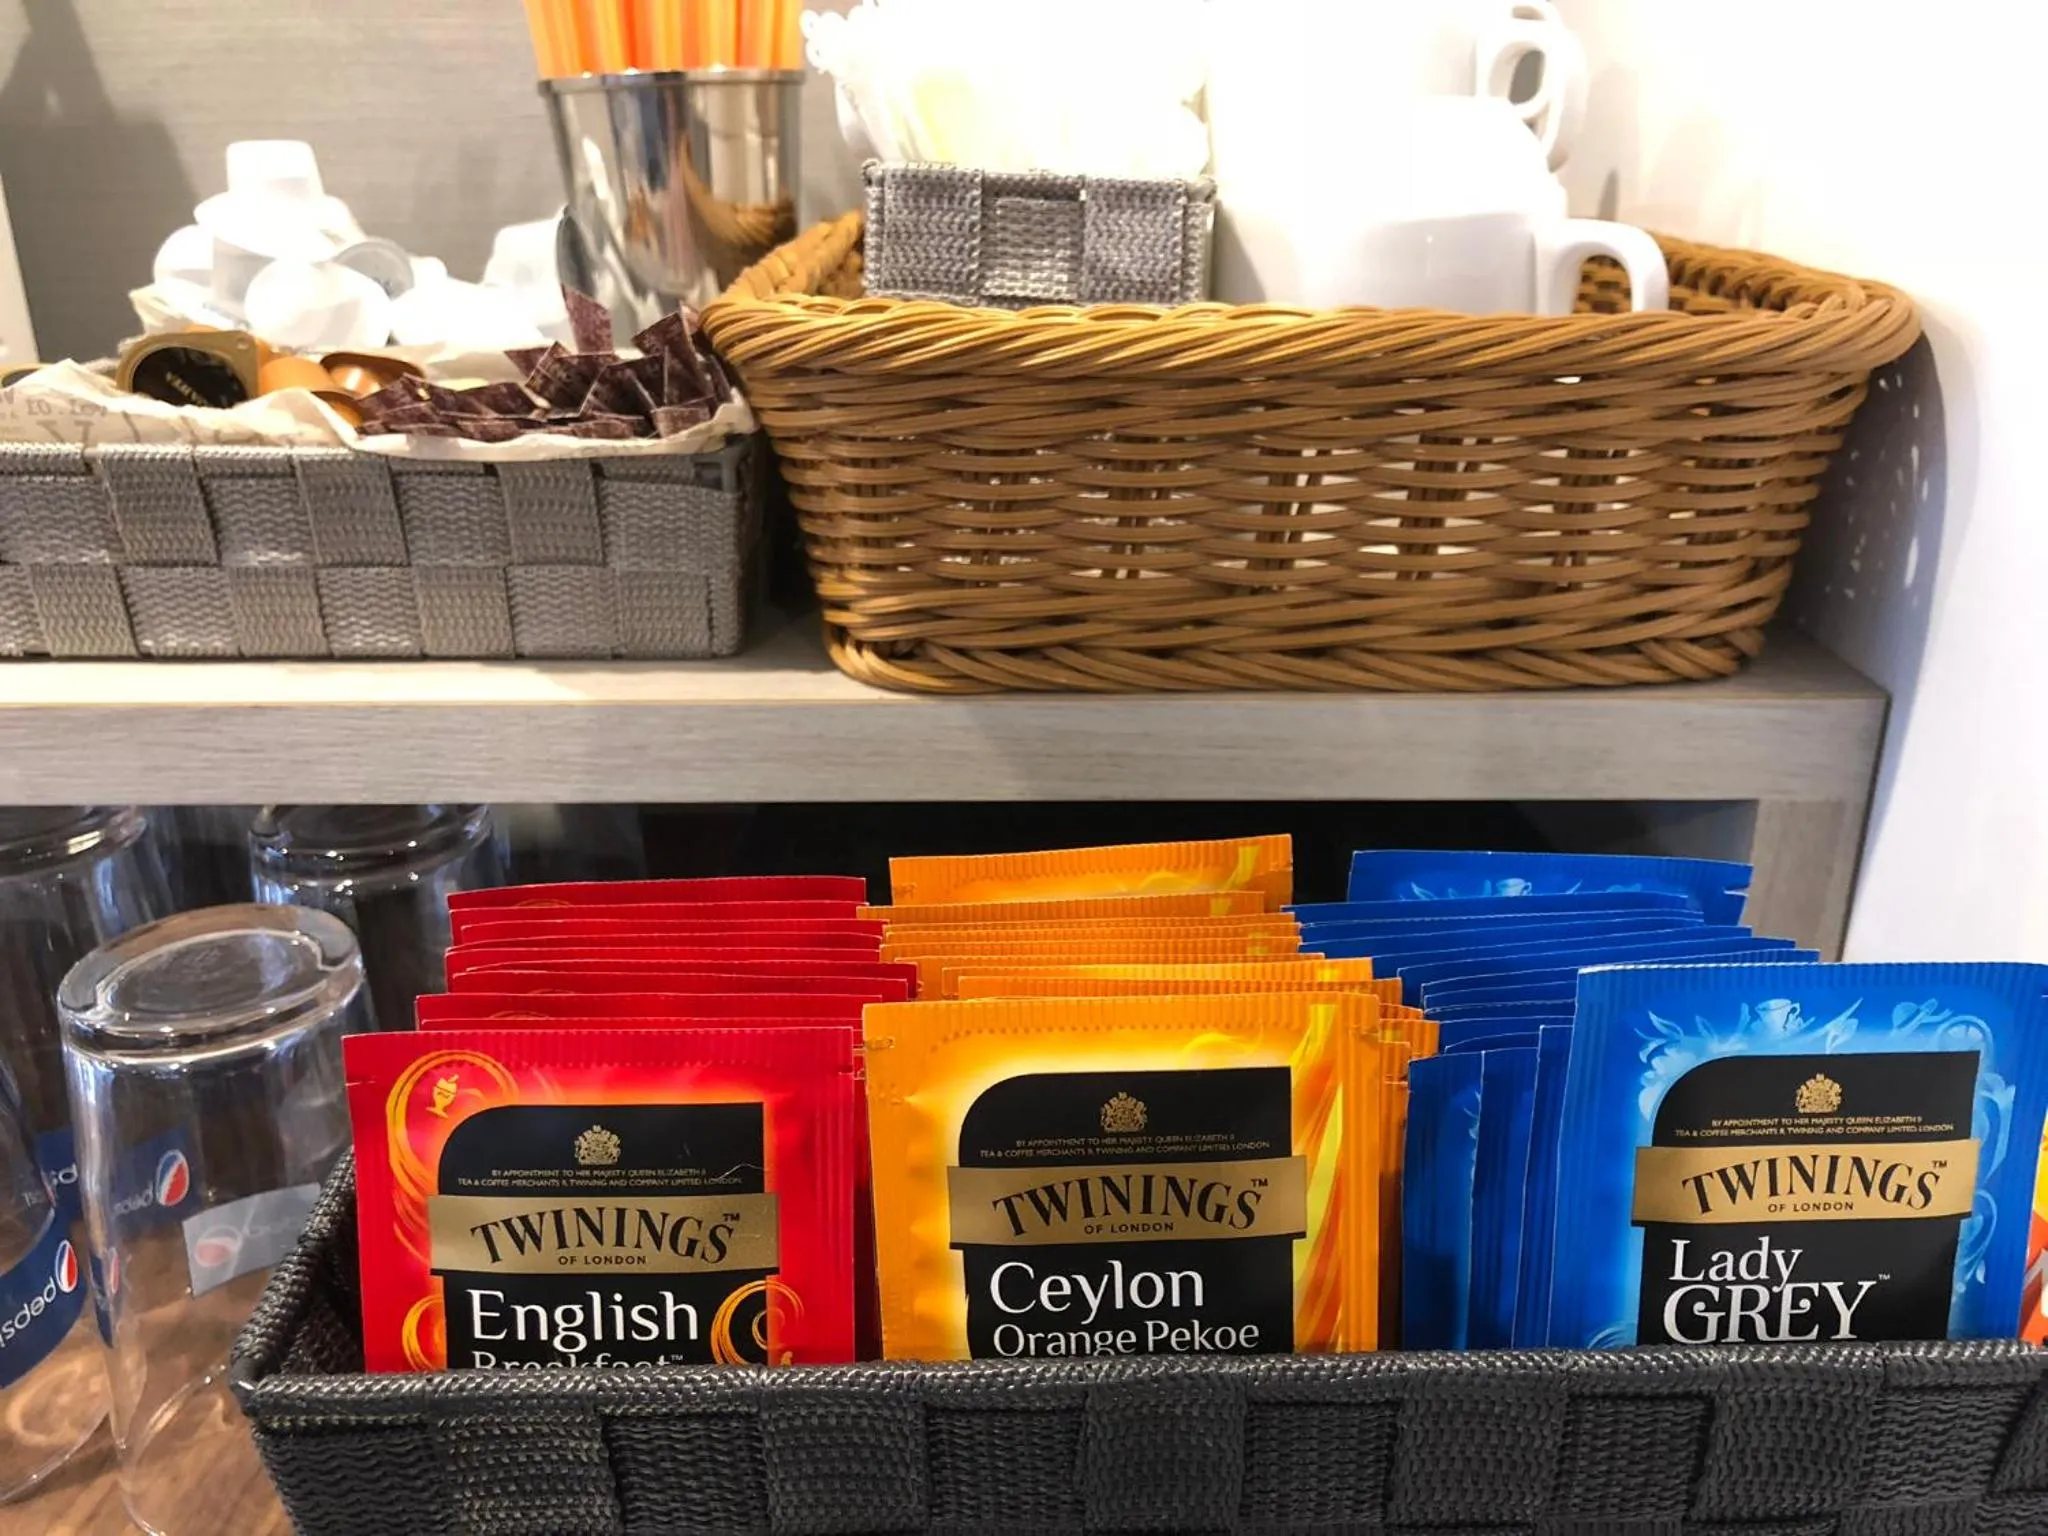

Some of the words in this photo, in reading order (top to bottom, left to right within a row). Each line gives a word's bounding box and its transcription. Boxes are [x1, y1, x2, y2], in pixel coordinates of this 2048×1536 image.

[1768, 1202, 1786, 1213] OF
[1793, 1200, 1854, 1212] LONDON
[1084, 1223, 1104, 1235] OF
[1110, 1222, 1174, 1234] LONDON
[558, 1255, 577, 1266] OF
[584, 1255, 647, 1266] LONDON
[1668, 1235, 1803, 1293] Lady
[990, 1259, 1204, 1325] Ceylon
[465, 1288, 699, 1354] English
[993, 1323, 1137, 1357] Orange
[1146, 1319, 1260, 1352] Pekoe
